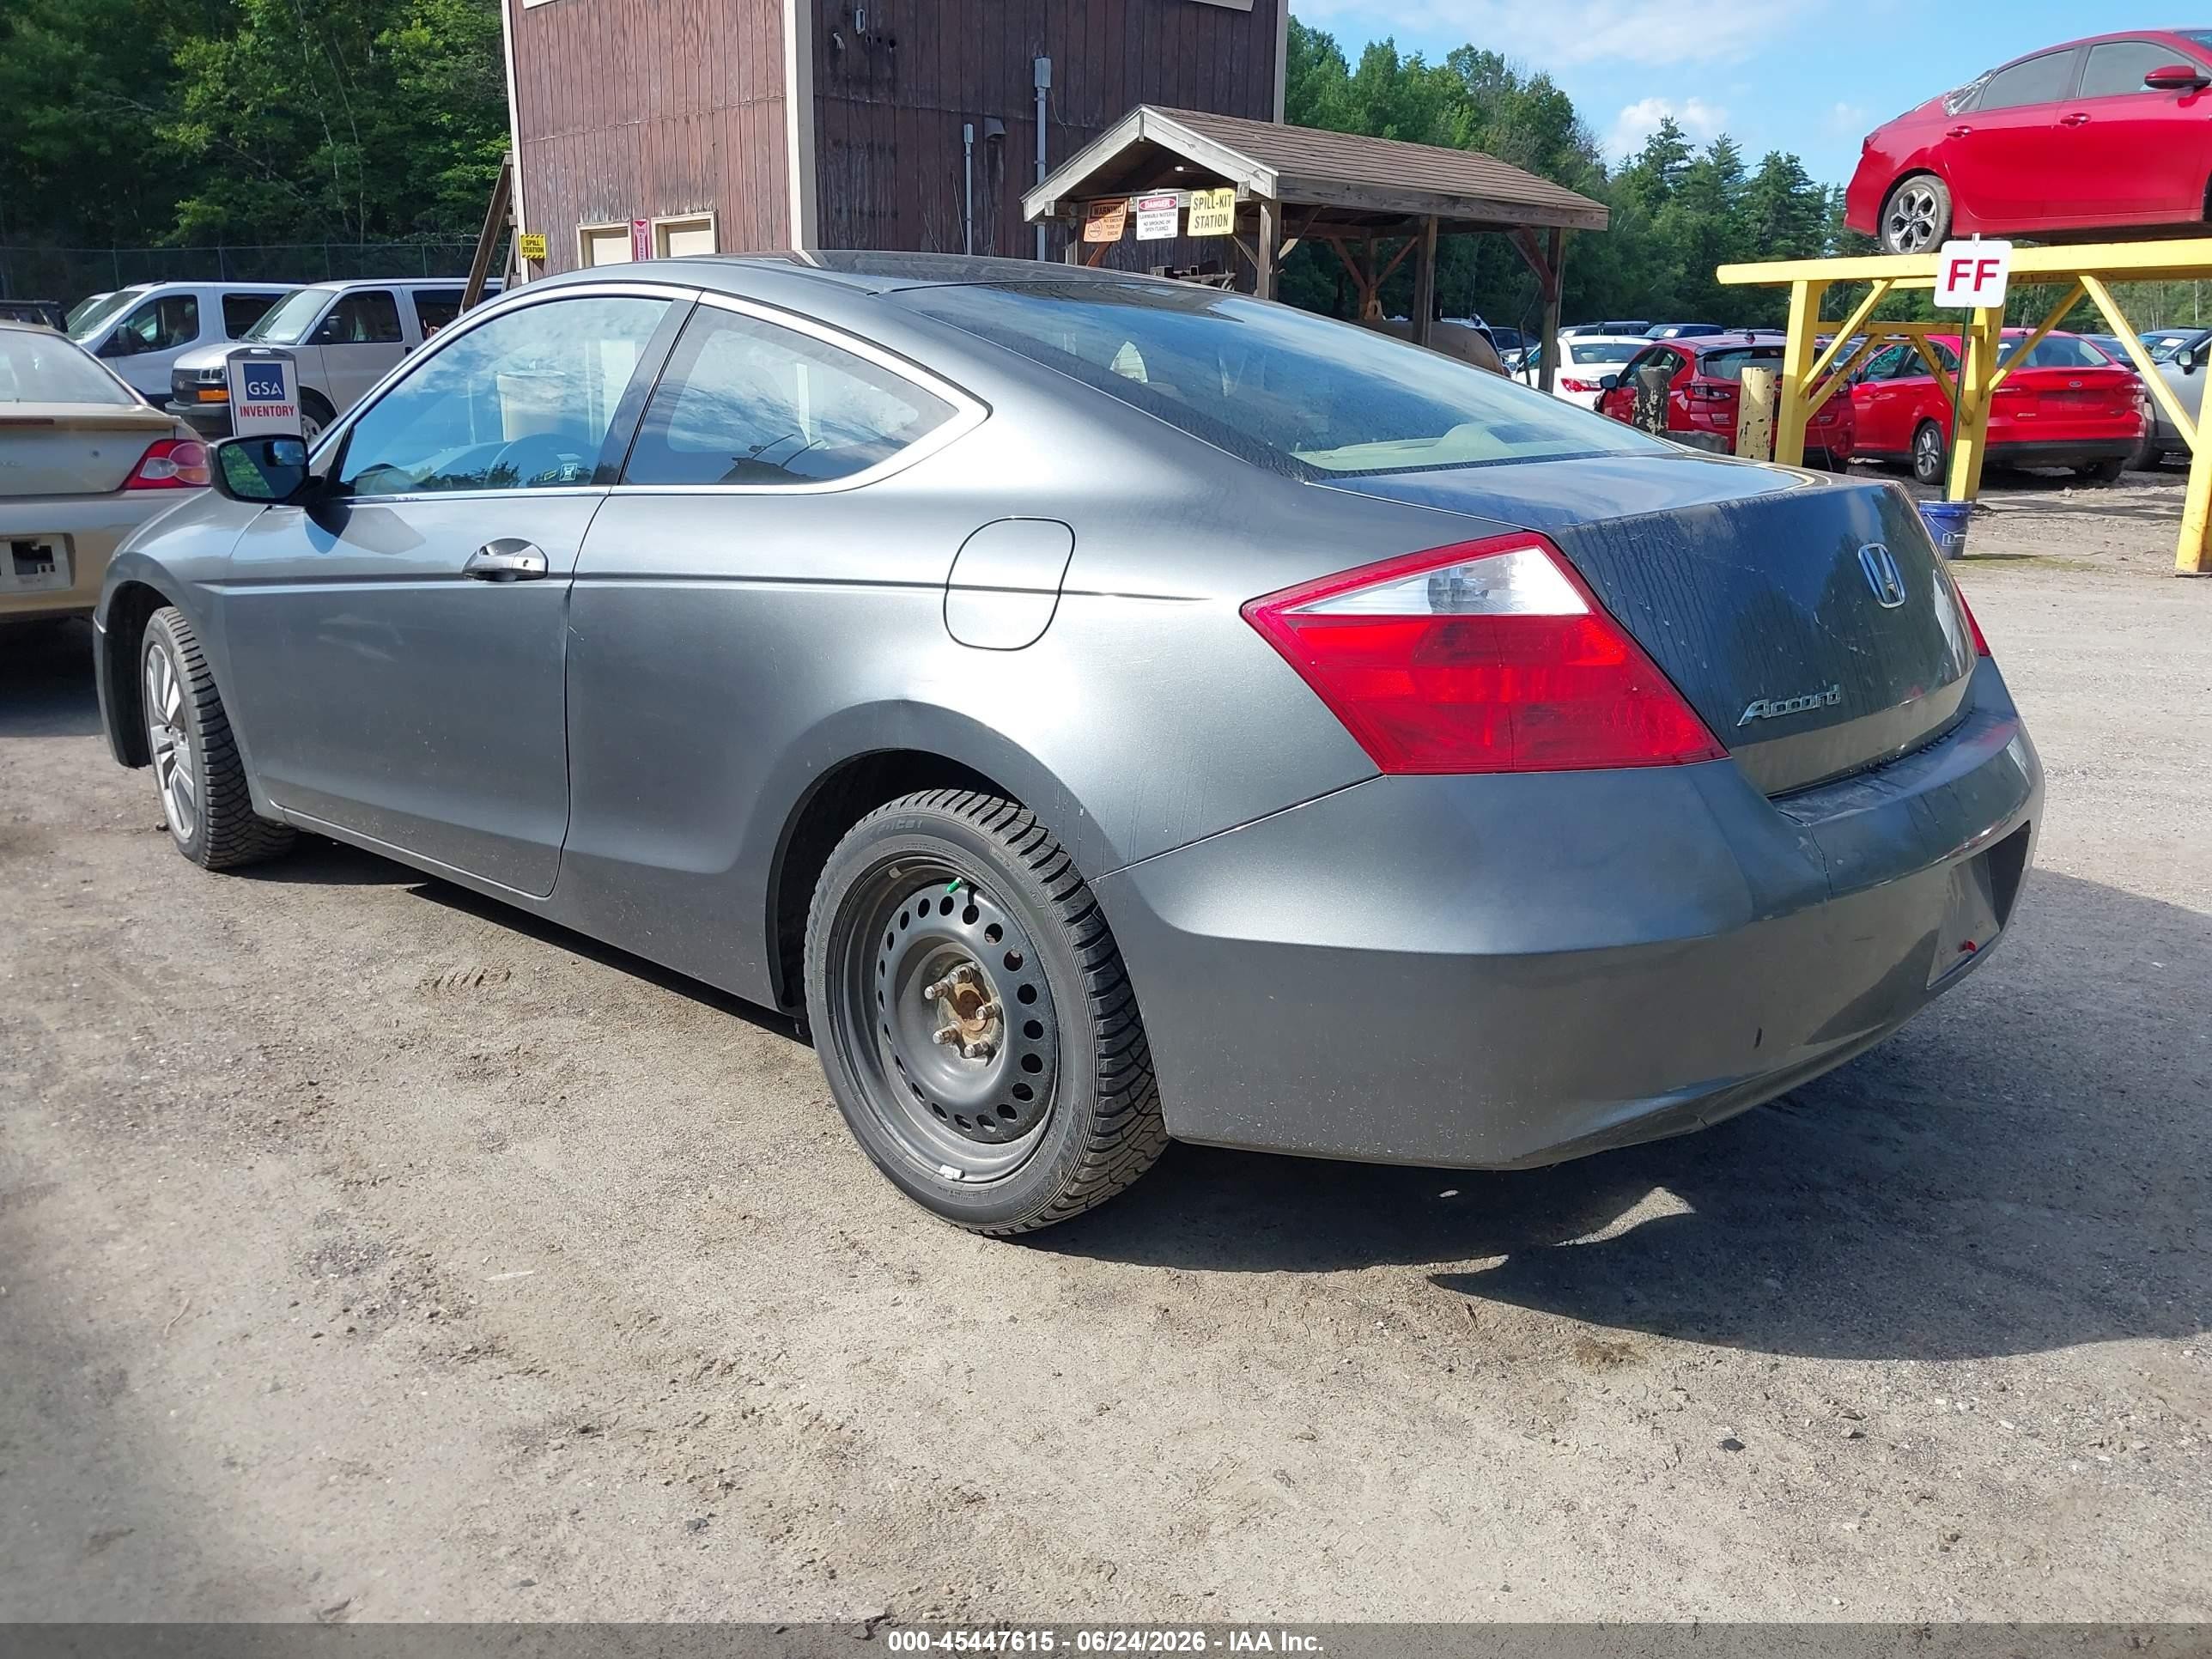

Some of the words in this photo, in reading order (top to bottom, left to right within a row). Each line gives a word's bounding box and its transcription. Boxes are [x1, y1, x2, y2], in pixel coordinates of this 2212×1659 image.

[1145, 200, 1170, 209] DANGER
[1194, 194, 1232, 210] SPILL-KIT
[1094, 205, 1121, 215] WARNING
[1194, 213, 1229, 229] STATION
[1948, 258, 2000, 292] FF
[248, 381, 283, 395] GSA
[240, 405, 295, 417] INVENTORY
[1735, 684, 1842, 727] Accord
